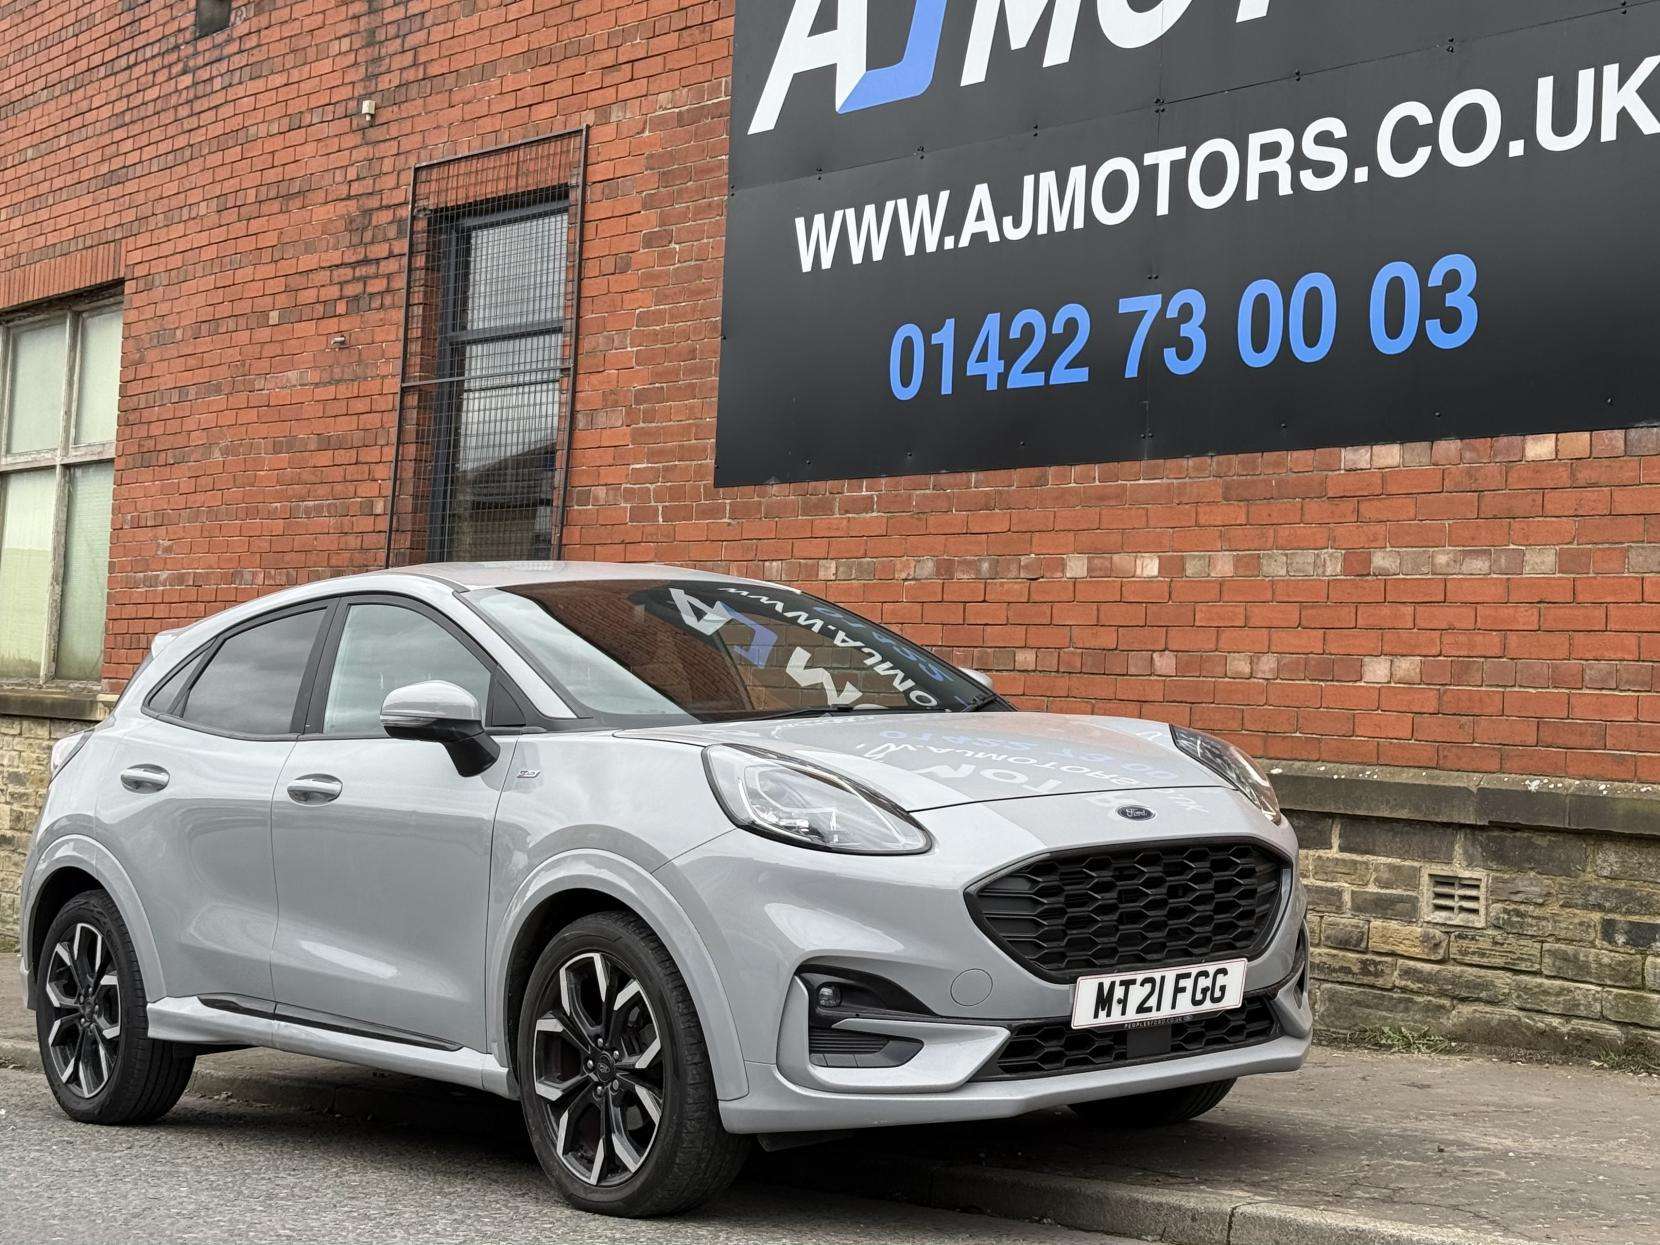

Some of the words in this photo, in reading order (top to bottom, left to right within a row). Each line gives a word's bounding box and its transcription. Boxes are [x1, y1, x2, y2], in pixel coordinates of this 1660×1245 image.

[795, 55, 1660, 272] WWW.AJMOTORS.CO.UK
[889, 303, 1091, 401] 01422
[1119, 289, 1207, 378] 73
[1237, 272, 1337, 368] 00
[1369, 253, 1479, 355] 03
[1093, 974, 1166, 1020] MT21
[1170, 967, 1229, 1011] FGG
